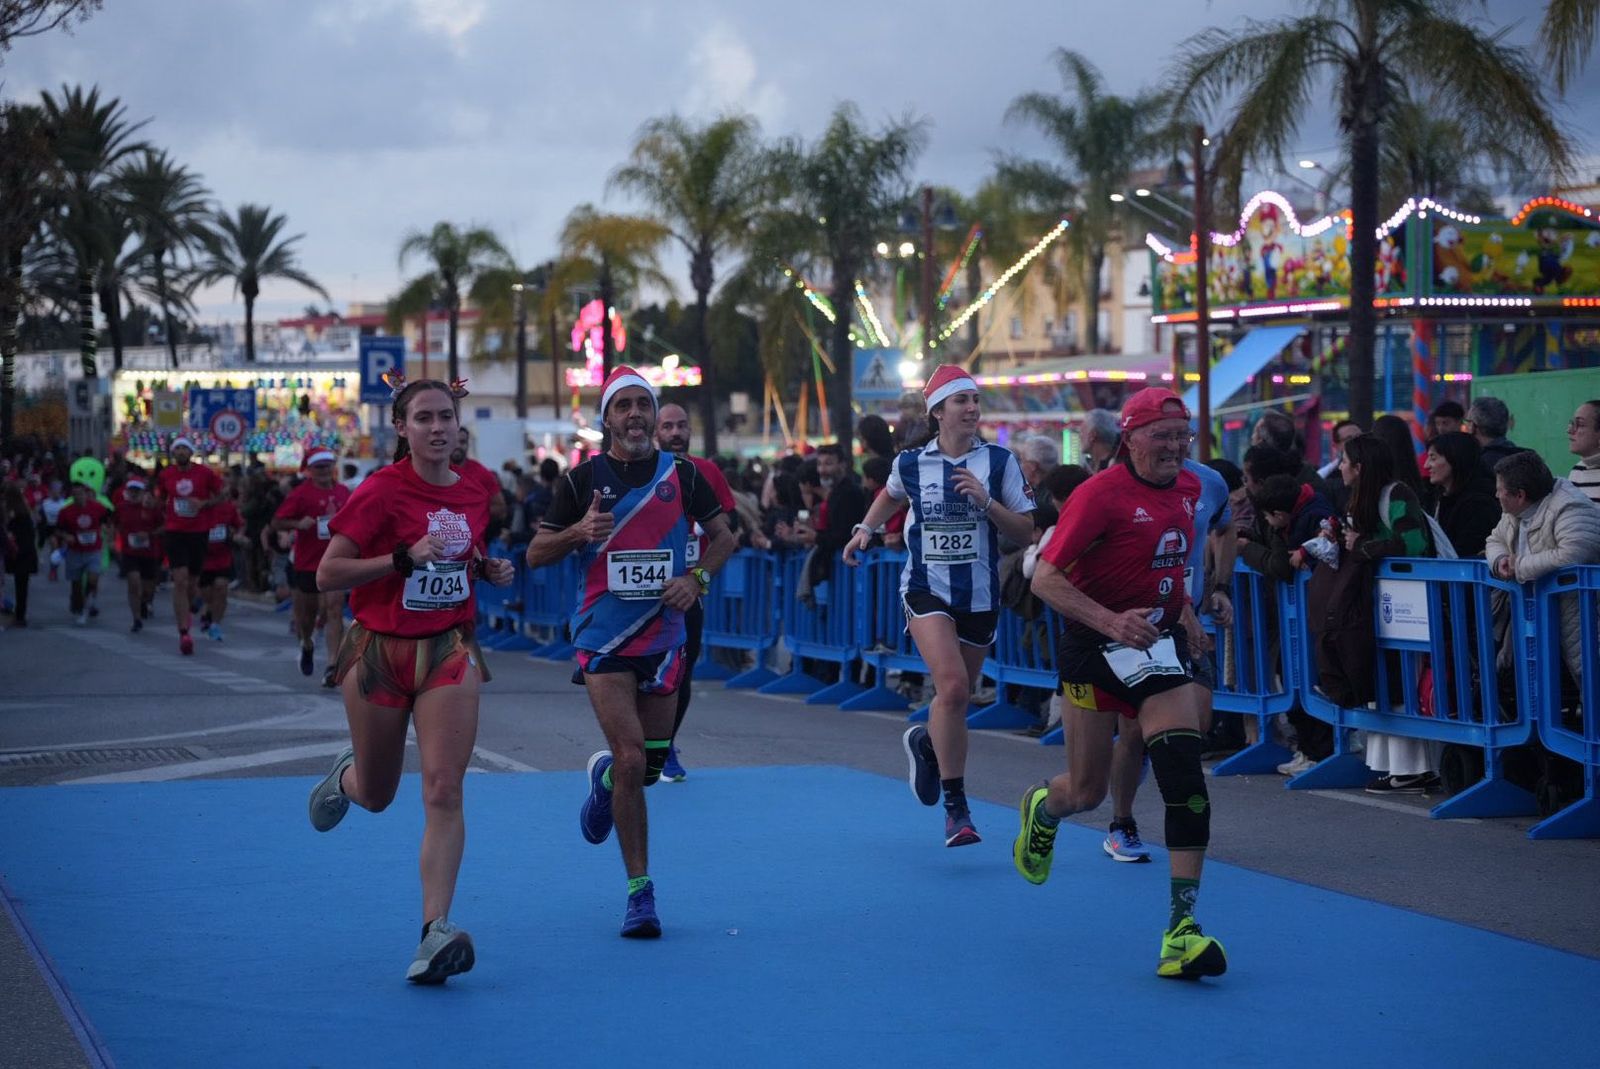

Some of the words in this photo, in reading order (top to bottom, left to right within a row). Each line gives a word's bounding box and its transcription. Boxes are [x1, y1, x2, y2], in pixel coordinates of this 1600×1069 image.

[367, 350, 395, 385] P
[221, 421, 236, 432] 10
[426, 511, 467, 521] Carrera
[440, 521, 460, 531] San
[930, 534, 973, 550] 1282
[618, 565, 666, 584] 1544
[417, 575, 464, 596] 1034
